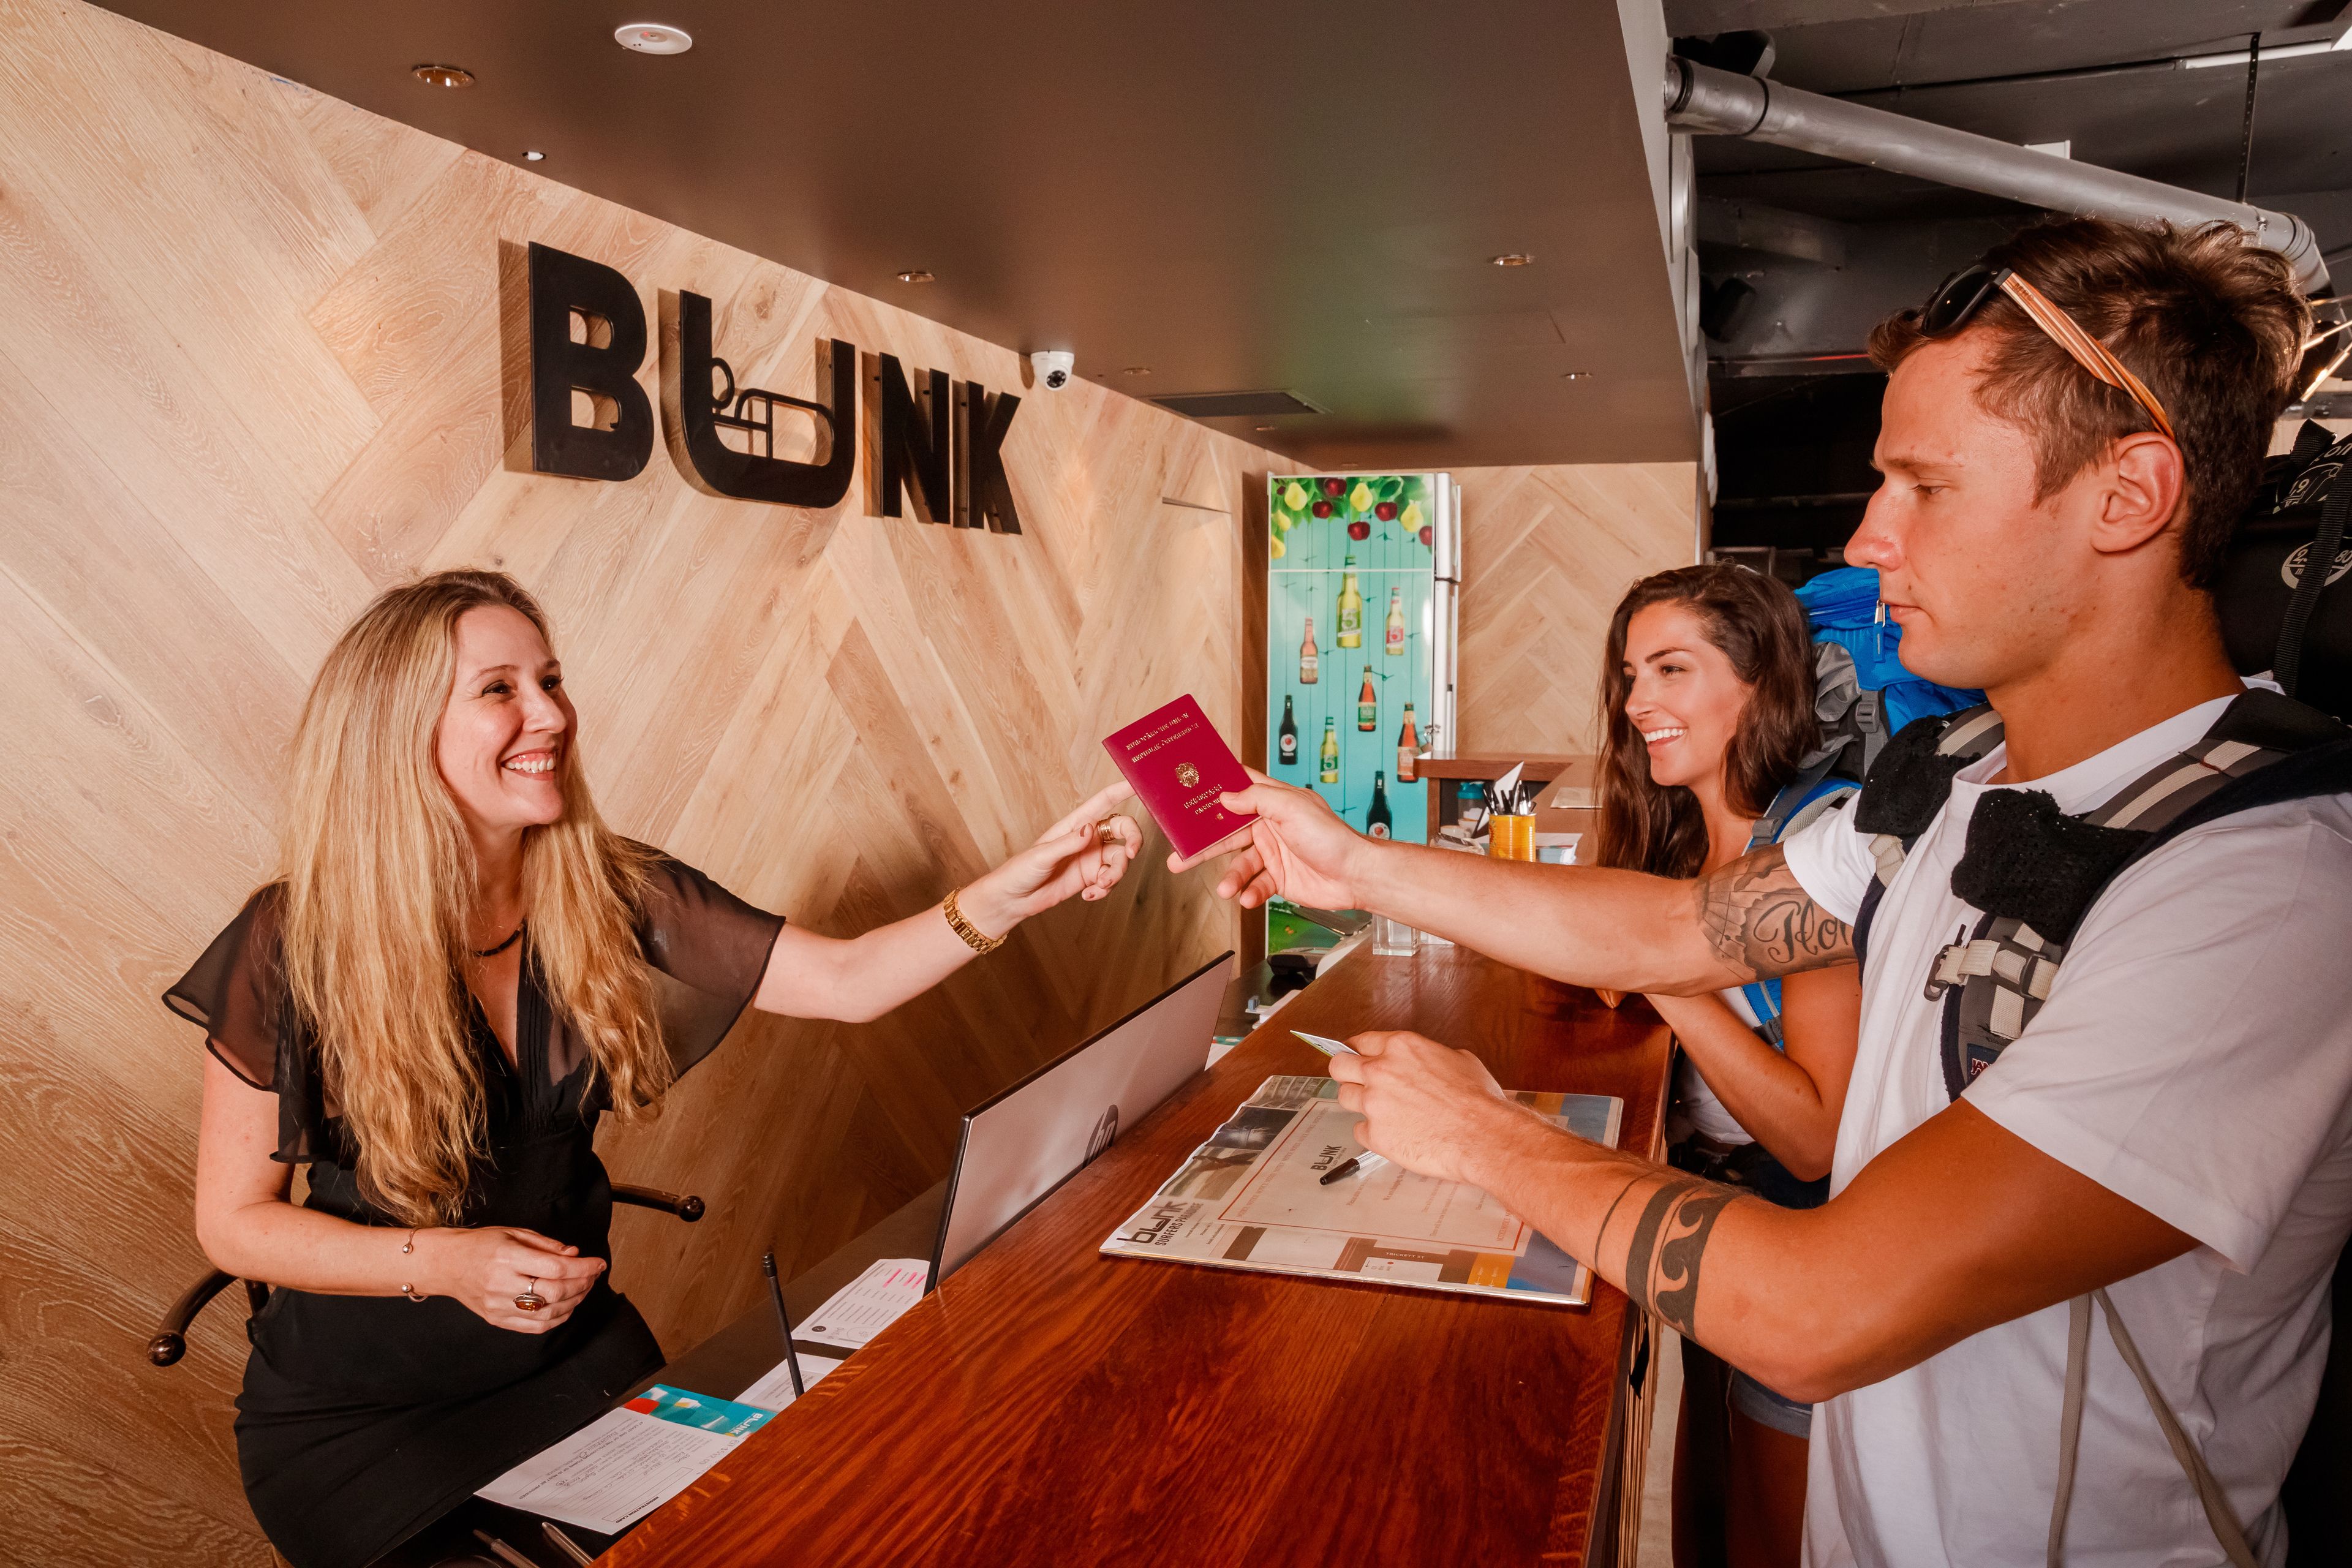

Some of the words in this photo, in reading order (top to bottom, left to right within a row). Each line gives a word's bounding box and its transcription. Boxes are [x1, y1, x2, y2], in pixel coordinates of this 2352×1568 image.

[529, 241, 1022, 535] BUNK
[1310, 1145, 1342, 1170] BUNK
[1117, 1201, 1188, 1243] bunk
[1155, 1222, 1183, 1246] SURFERS
[731, 1414, 763, 1434] BUNK
[628, 1496, 658, 1516] REGISTRATION
